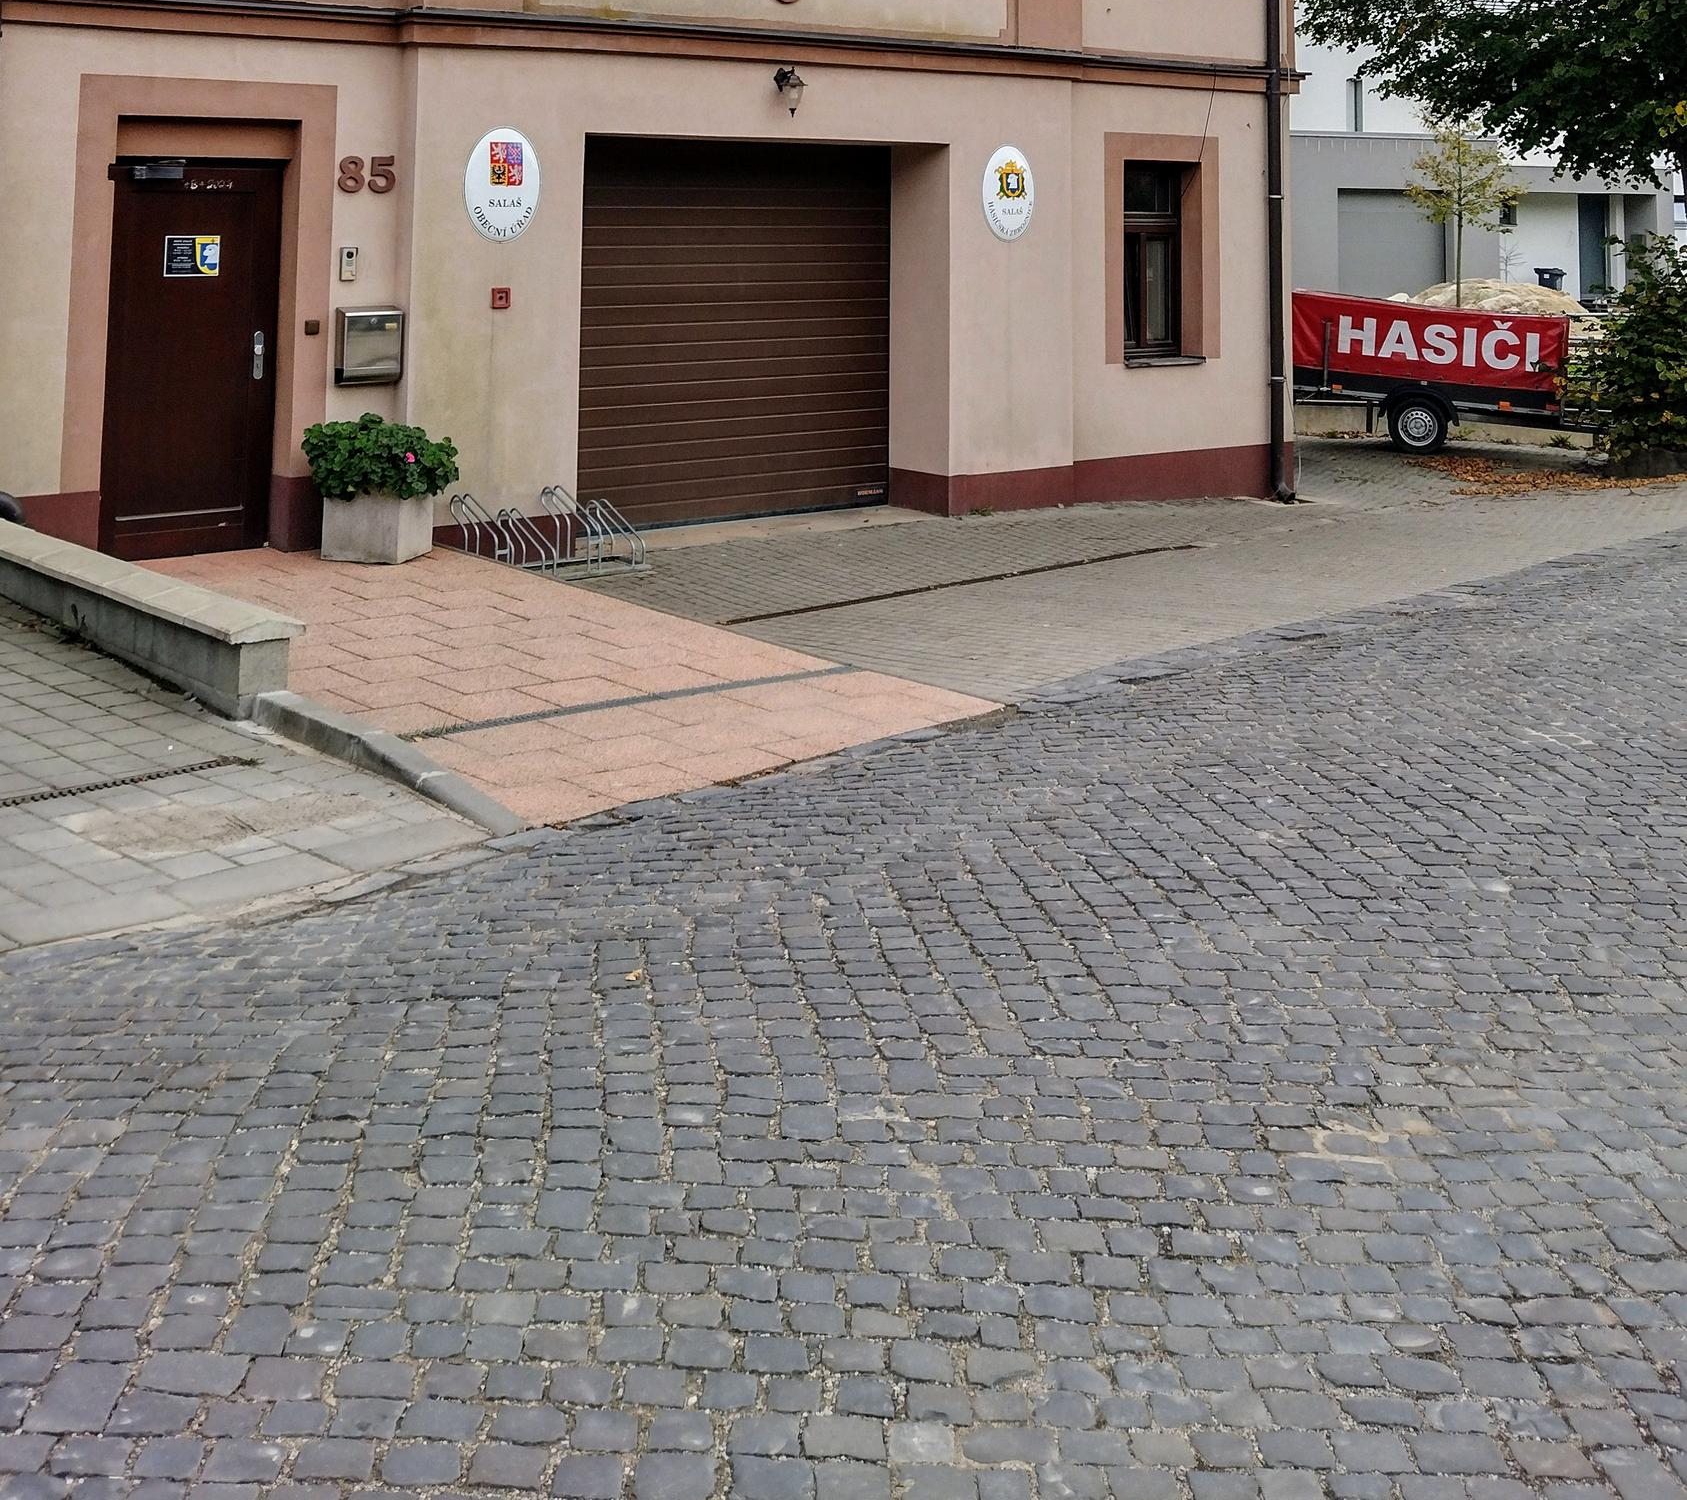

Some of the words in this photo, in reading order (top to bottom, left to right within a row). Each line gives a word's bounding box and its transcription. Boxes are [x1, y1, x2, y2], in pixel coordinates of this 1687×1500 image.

[338, 155, 396, 194] 85
[488, 197, 522, 208] SALAŠ
[1002, 206, 1023, 216] SALAŠ
[473, 205, 507, 237] OBECNÍ
[510, 206, 533, 235] ÚŘAD
[1337, 314, 1541, 373] HASIČI
